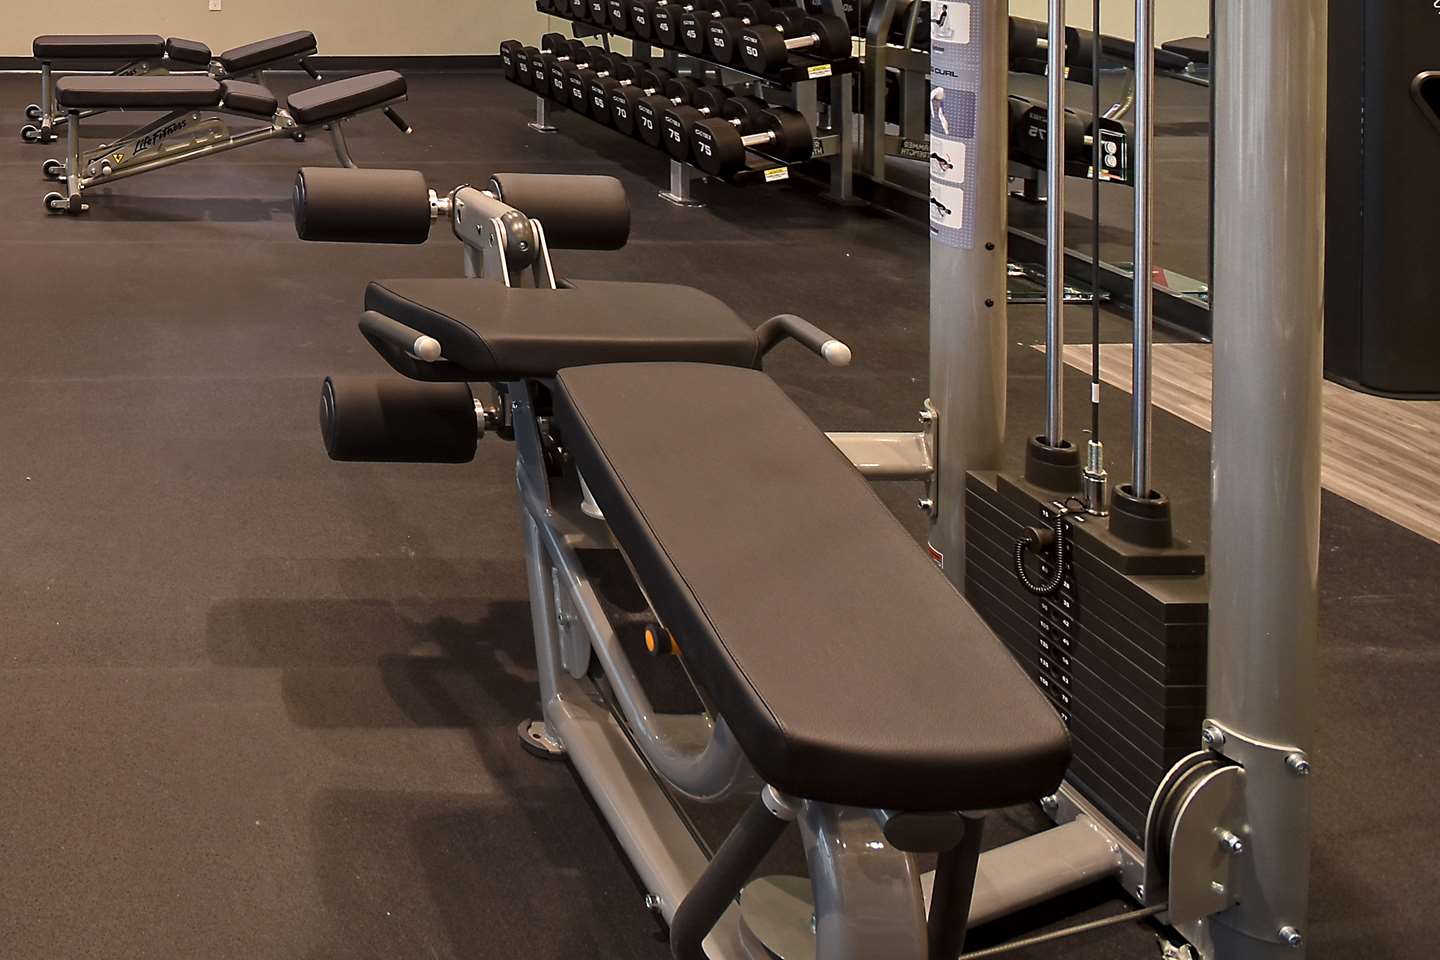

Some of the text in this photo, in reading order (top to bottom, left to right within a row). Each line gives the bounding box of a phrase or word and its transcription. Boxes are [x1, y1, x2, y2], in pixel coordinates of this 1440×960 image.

[686, 30, 696, 38] 45
[714, 37, 724, 47] 50
[745, 45, 758, 57] 50
[616, 106, 627, 119] 70
[641, 116, 653, 130] 70
[668, 128, 680, 142] 75
[698, 141, 711, 156] 75
